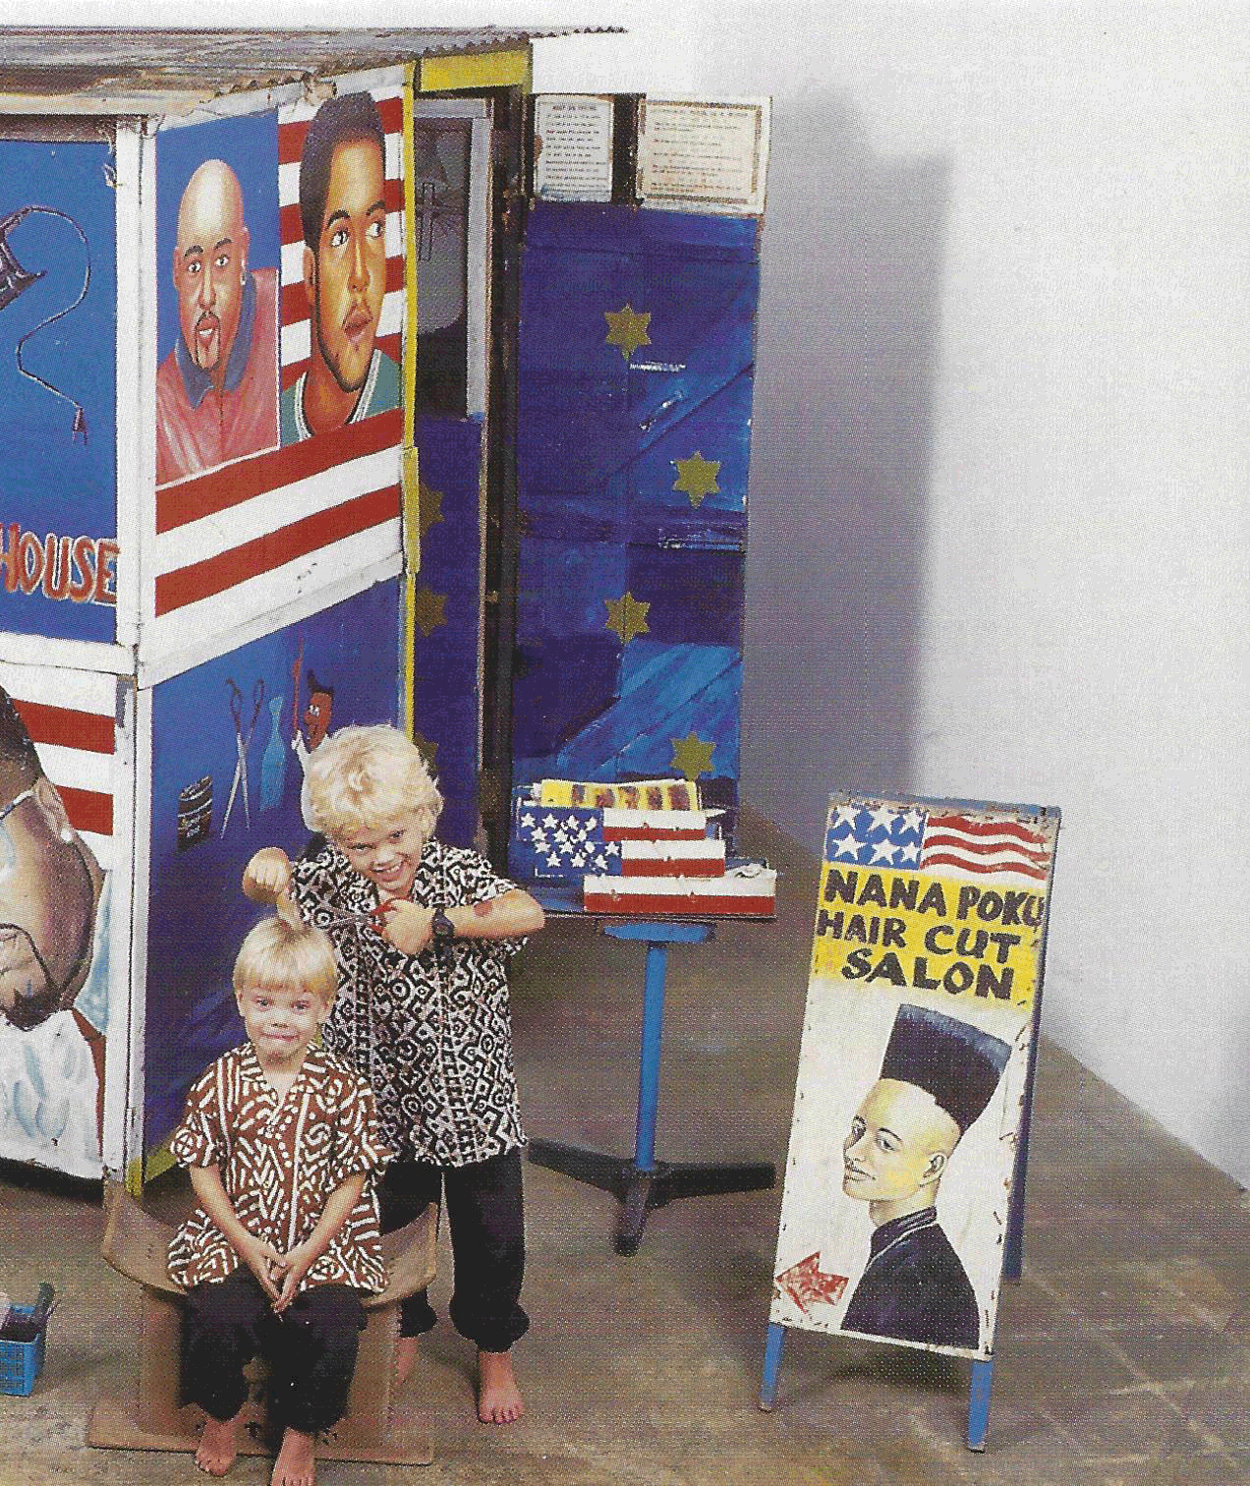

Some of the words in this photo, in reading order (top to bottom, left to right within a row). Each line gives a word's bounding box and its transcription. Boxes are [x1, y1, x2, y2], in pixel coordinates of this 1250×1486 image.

[824, 869, 947, 917] NANA
[955, 885, 1046, 927] POKU
[816, 909, 907, 948] HAIR
[923, 925, 1022, 964] CUT
[841, 948, 1015, 1000] SALON
